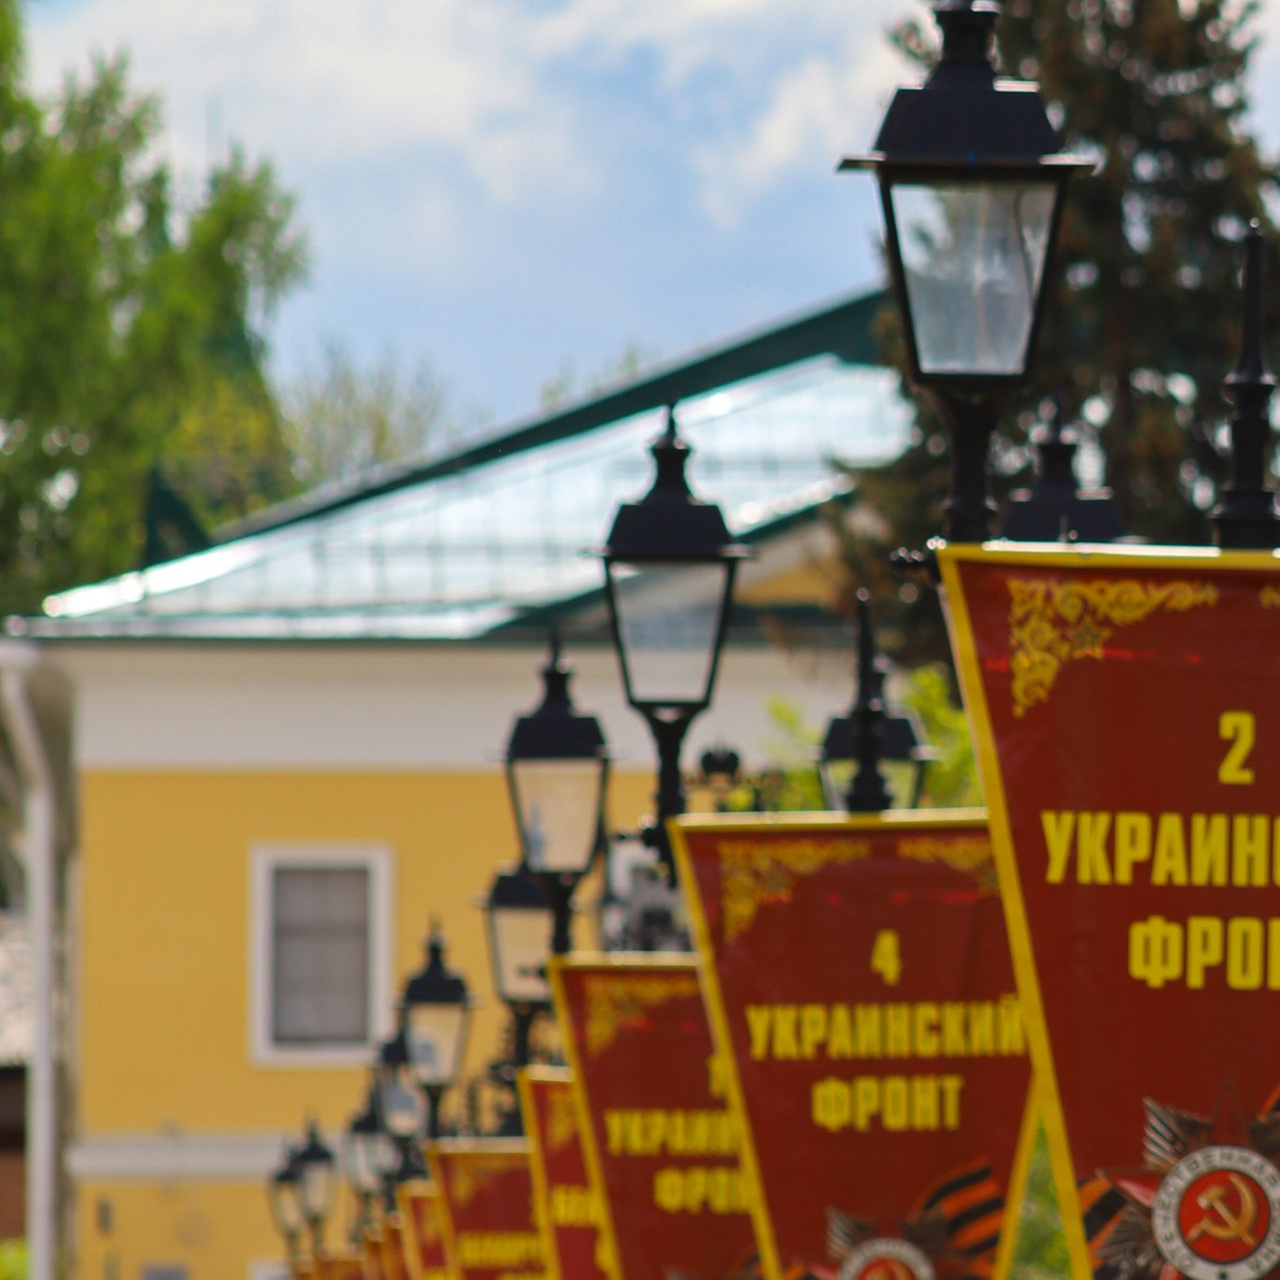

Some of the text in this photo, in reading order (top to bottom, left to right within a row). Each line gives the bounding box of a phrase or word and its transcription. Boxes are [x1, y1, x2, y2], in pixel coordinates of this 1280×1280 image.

[1218, 711, 1256, 785] 2
[871, 930, 902, 986] 4
[746, 993, 1024, 1060] УКРАИНСКИЙ
[812, 1075, 963, 1131] ФРОНТ
